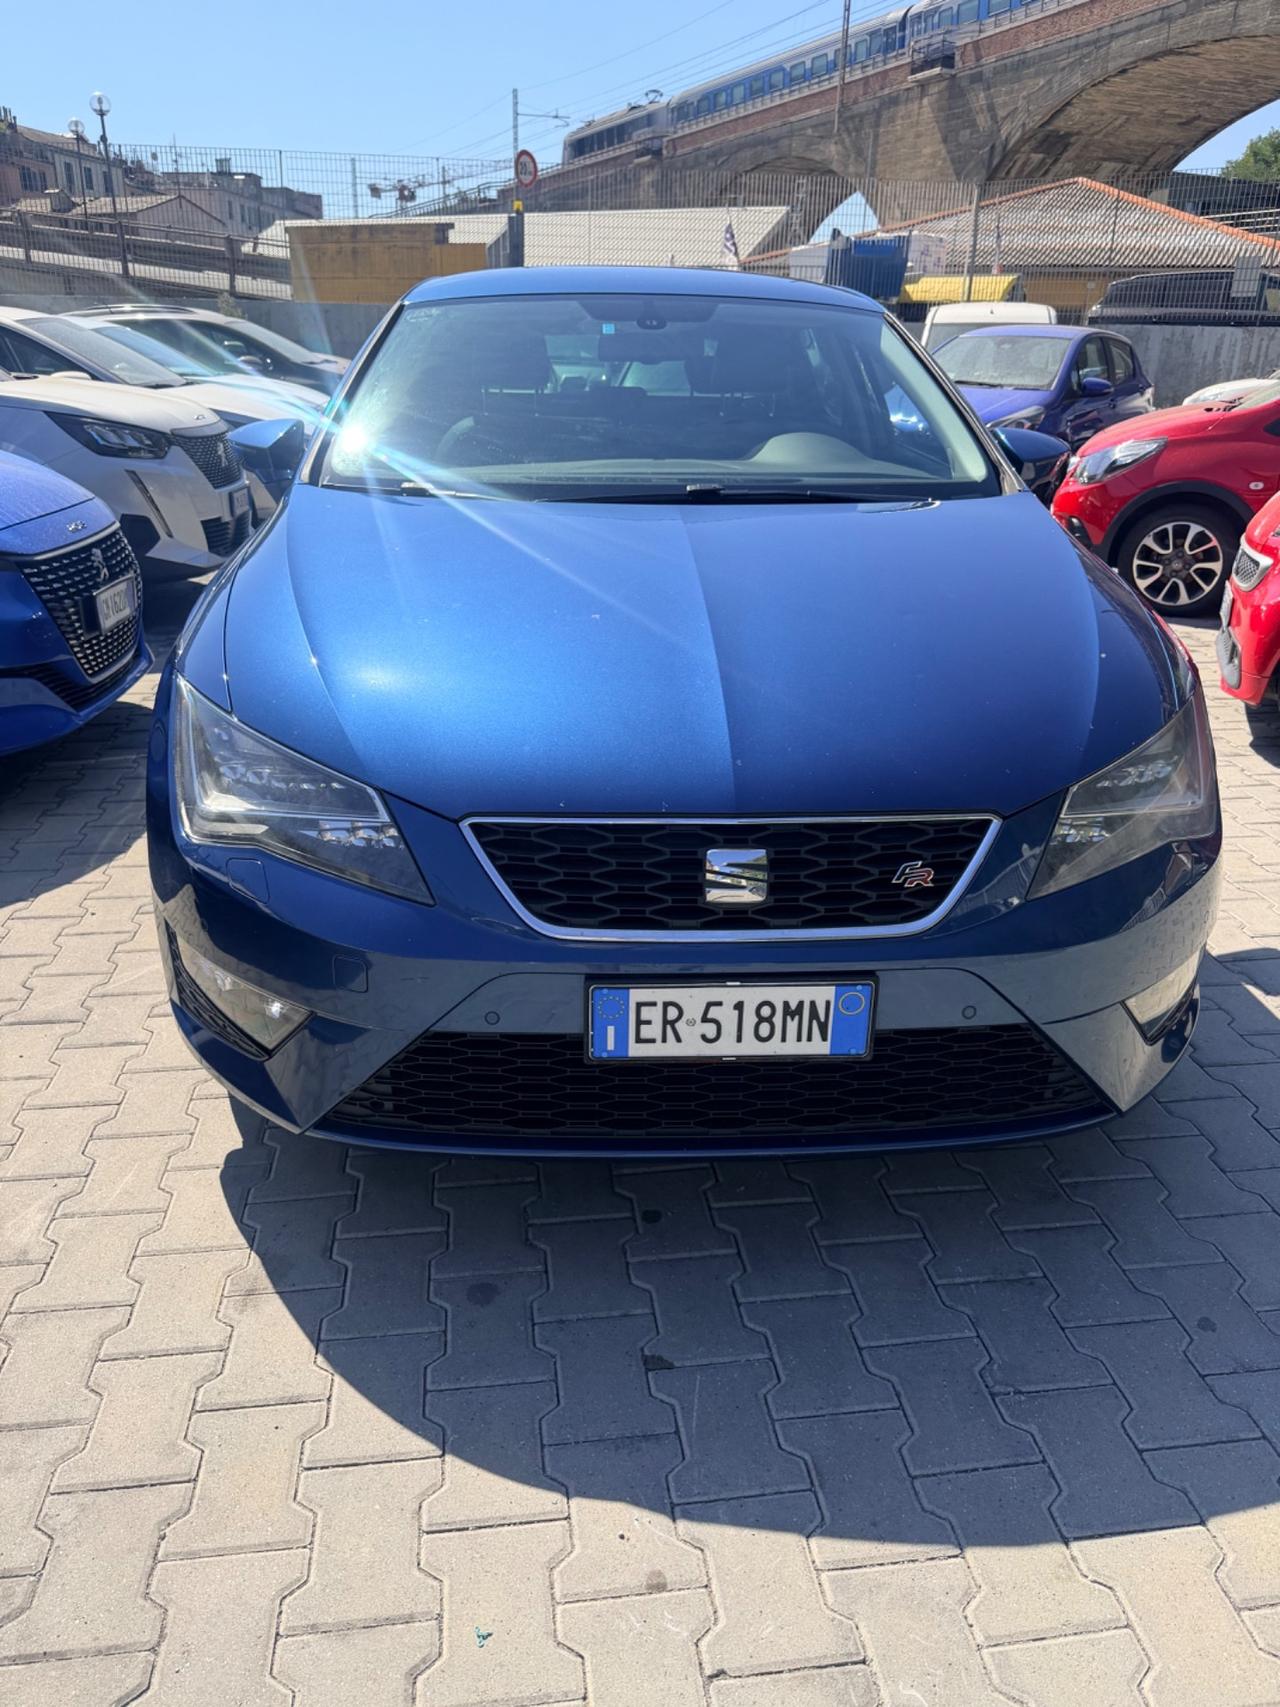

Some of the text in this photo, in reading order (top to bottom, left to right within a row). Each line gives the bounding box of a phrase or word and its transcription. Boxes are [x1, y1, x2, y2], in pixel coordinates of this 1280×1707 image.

[891, 860, 935, 888] FR
[634, 999, 831, 1044] ER 518MN
